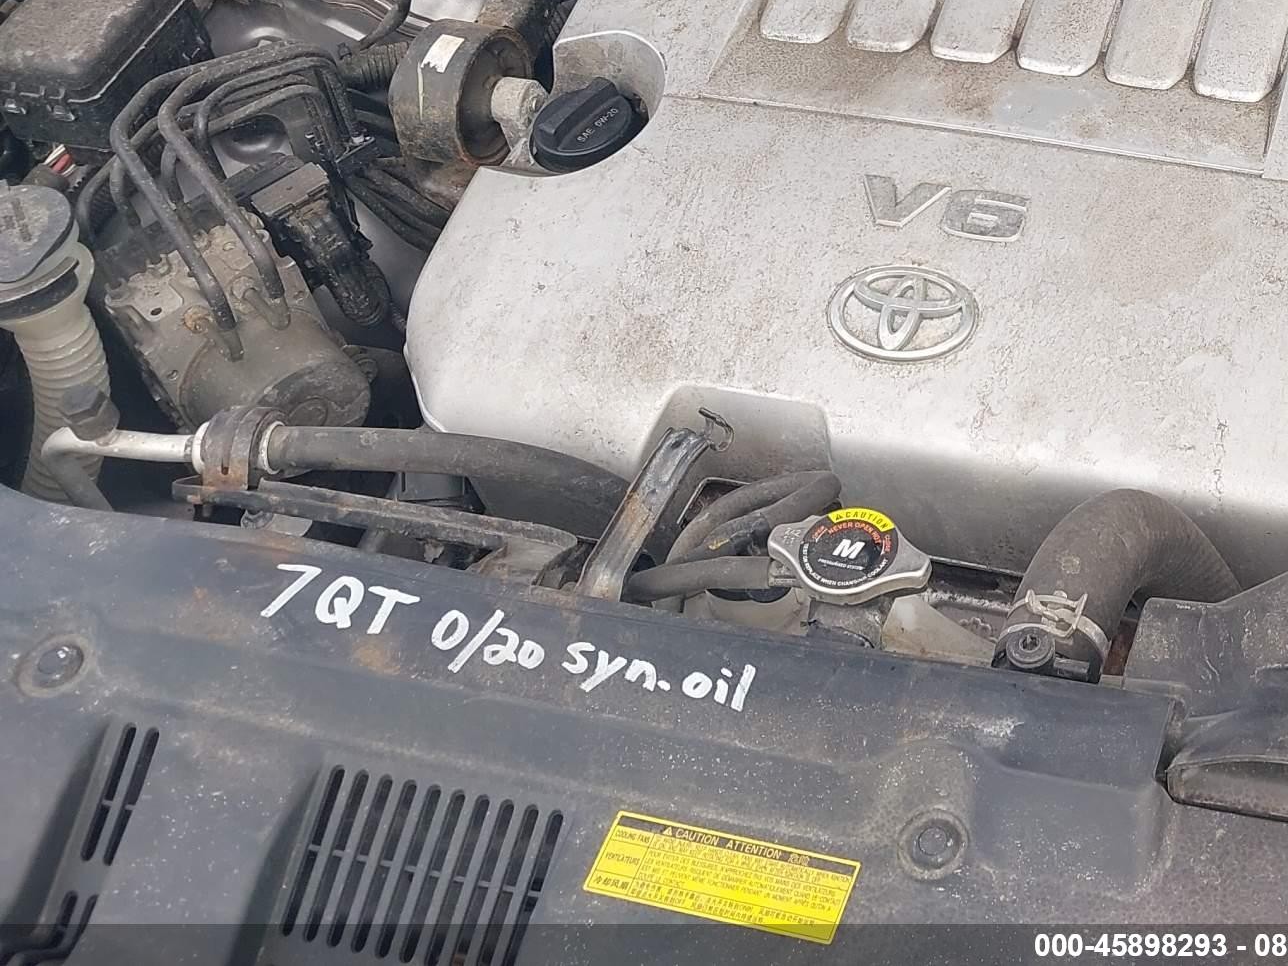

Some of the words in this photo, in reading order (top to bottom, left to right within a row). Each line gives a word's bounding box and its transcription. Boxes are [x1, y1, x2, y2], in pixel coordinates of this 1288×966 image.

[576, 128, 595, 143] SAE
[594, 107, 619, 128] 0W-20
[862, 174, 1030, 244] V6
[827, 521, 853, 536] NEVER
[854, 521, 874, 534] OPEN
[870, 529, 882, 545] HOT
[845, 511, 888, 530] CAUTION
[260, 564, 322, 618] 7
[314, 575, 421, 636] QT
[431, 609, 545, 674] 0/20
[561, 641, 671, 694] syn.
[681, 664, 756, 712] oil
[636, 833, 651, 844] FANS
[673, 828, 721, 846] CAUTION
[724, 839, 783, 860] ATTENTION
